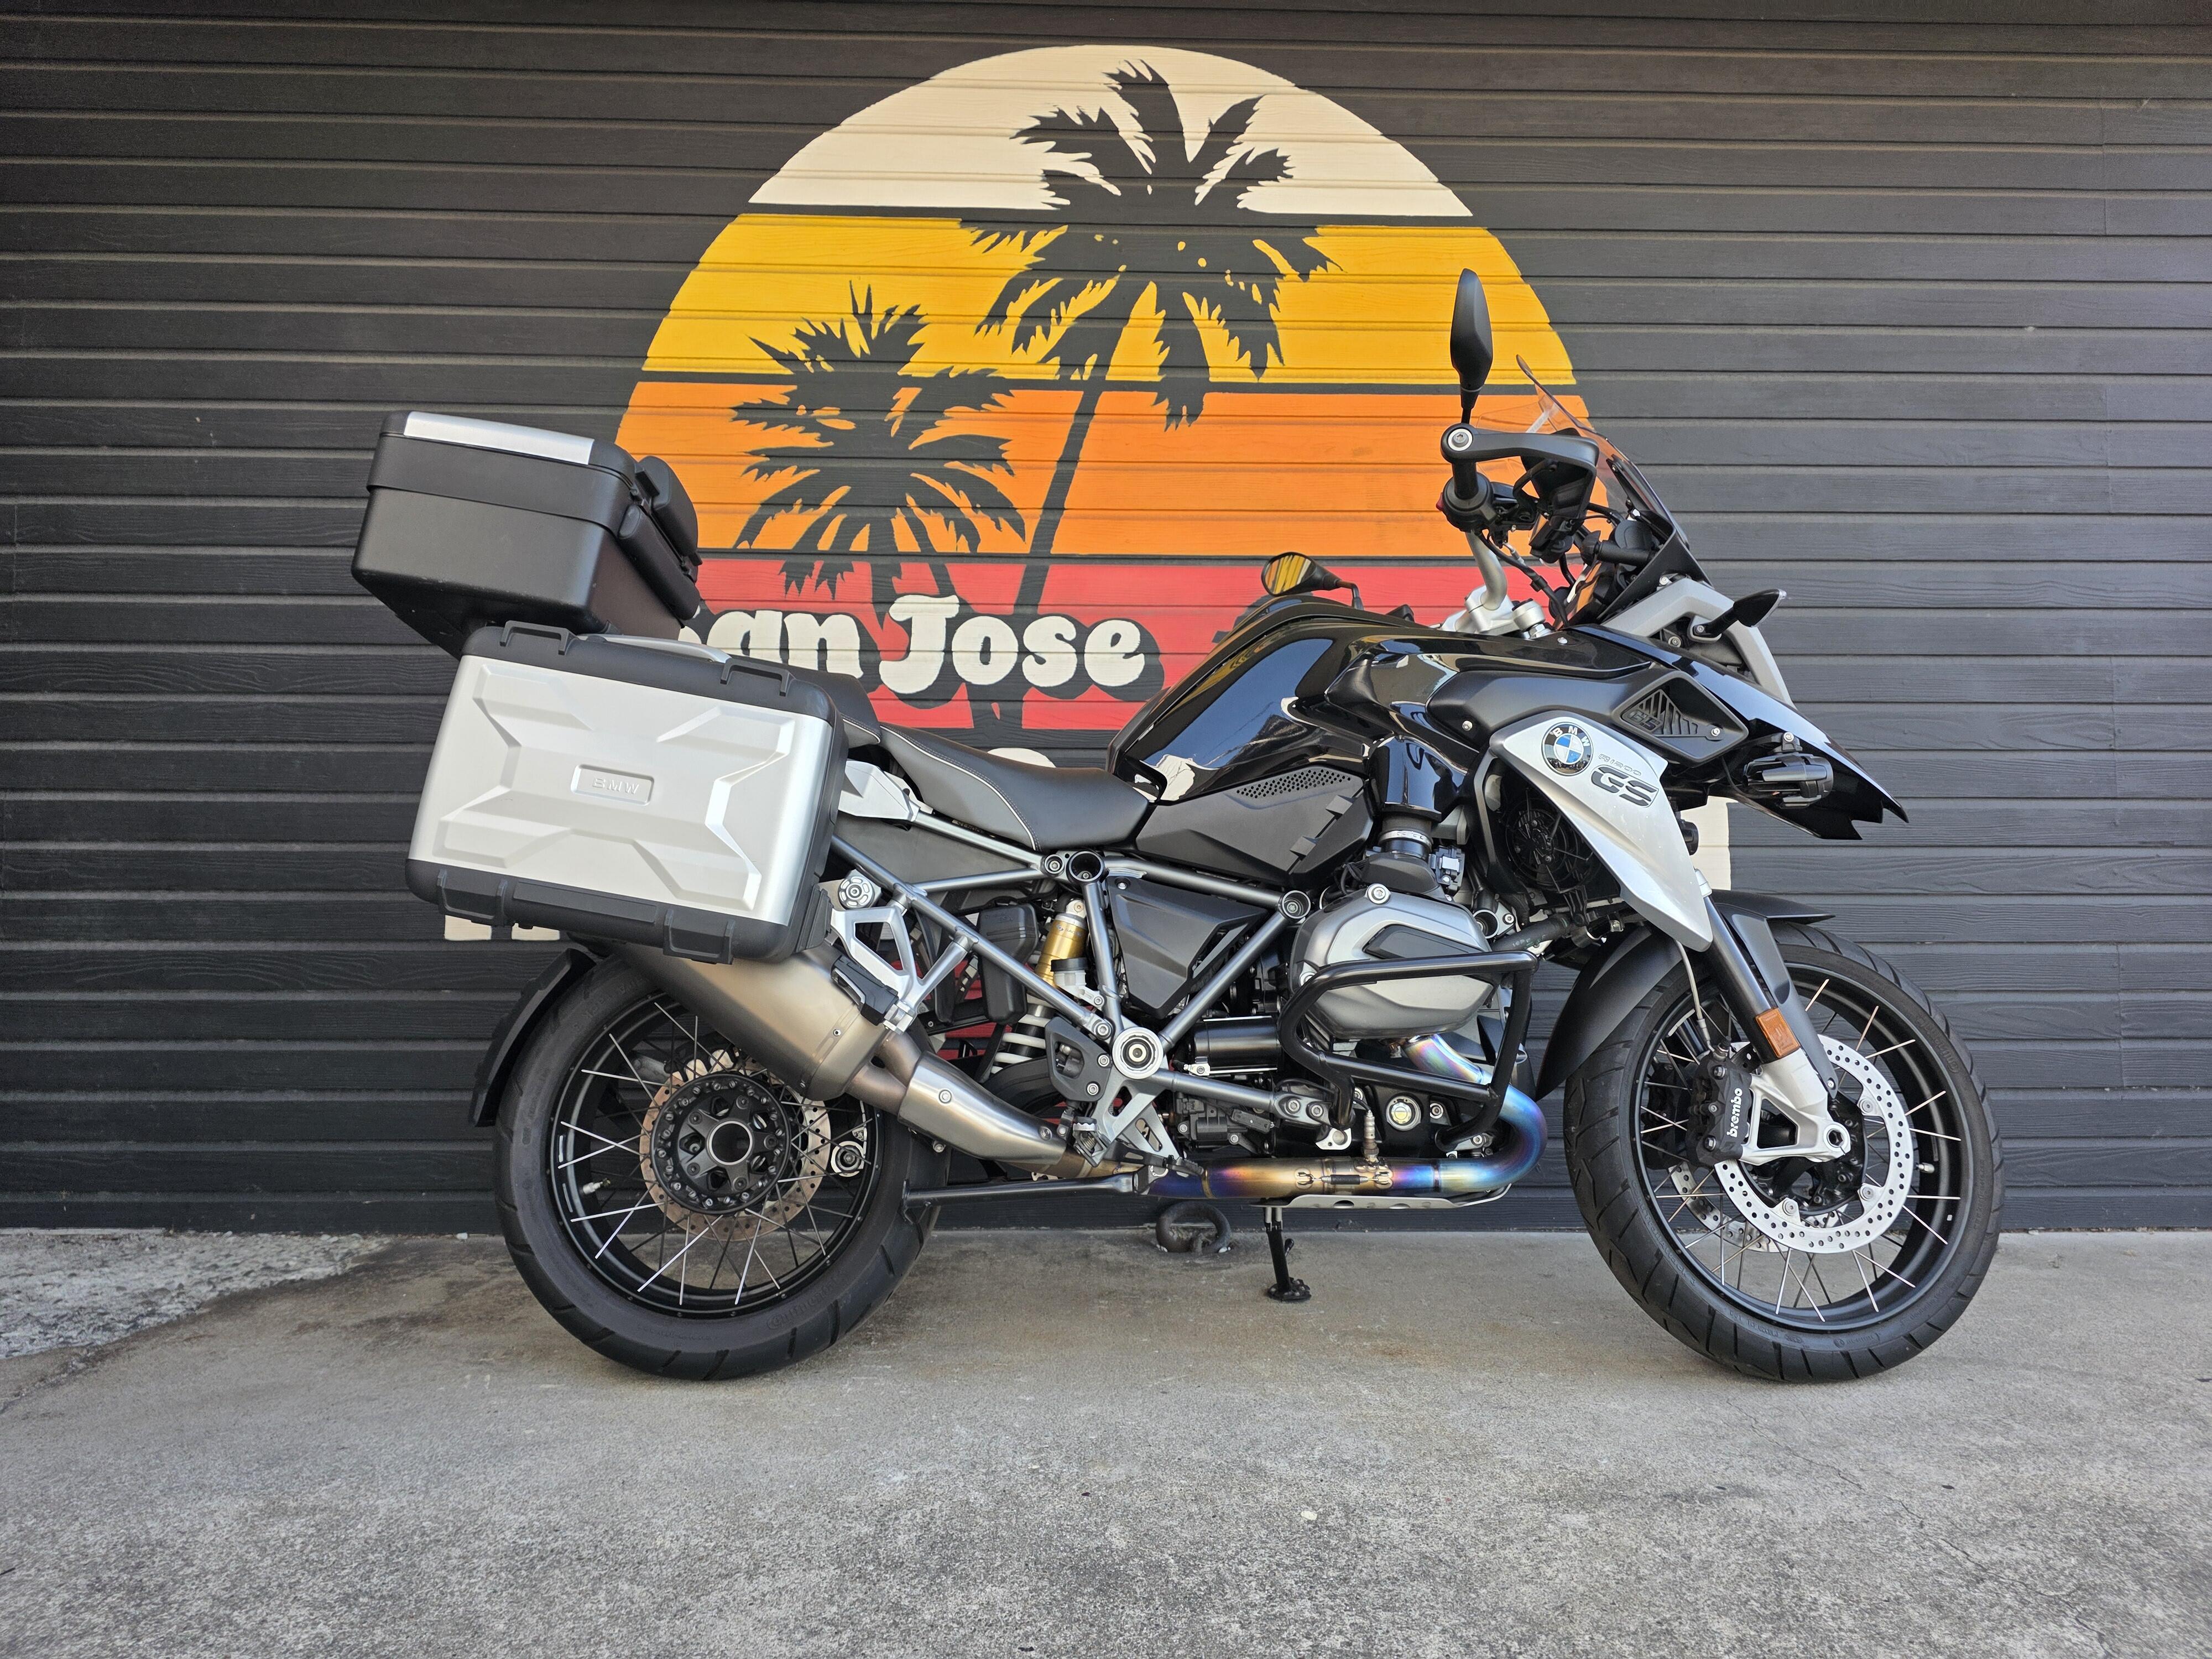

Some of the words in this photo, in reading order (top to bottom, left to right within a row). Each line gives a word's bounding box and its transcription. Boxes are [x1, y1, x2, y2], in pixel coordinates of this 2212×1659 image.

[678, 605, 863, 679] an
[879, 594, 1145, 694] Jose
[1552, 725, 1591, 747] BMW
[1598, 753, 1642, 777] R1200
[592, 778, 640, 795] BMW
[1591, 766, 1658, 807] GS
[1726, 1087, 1743, 1138] brembo
